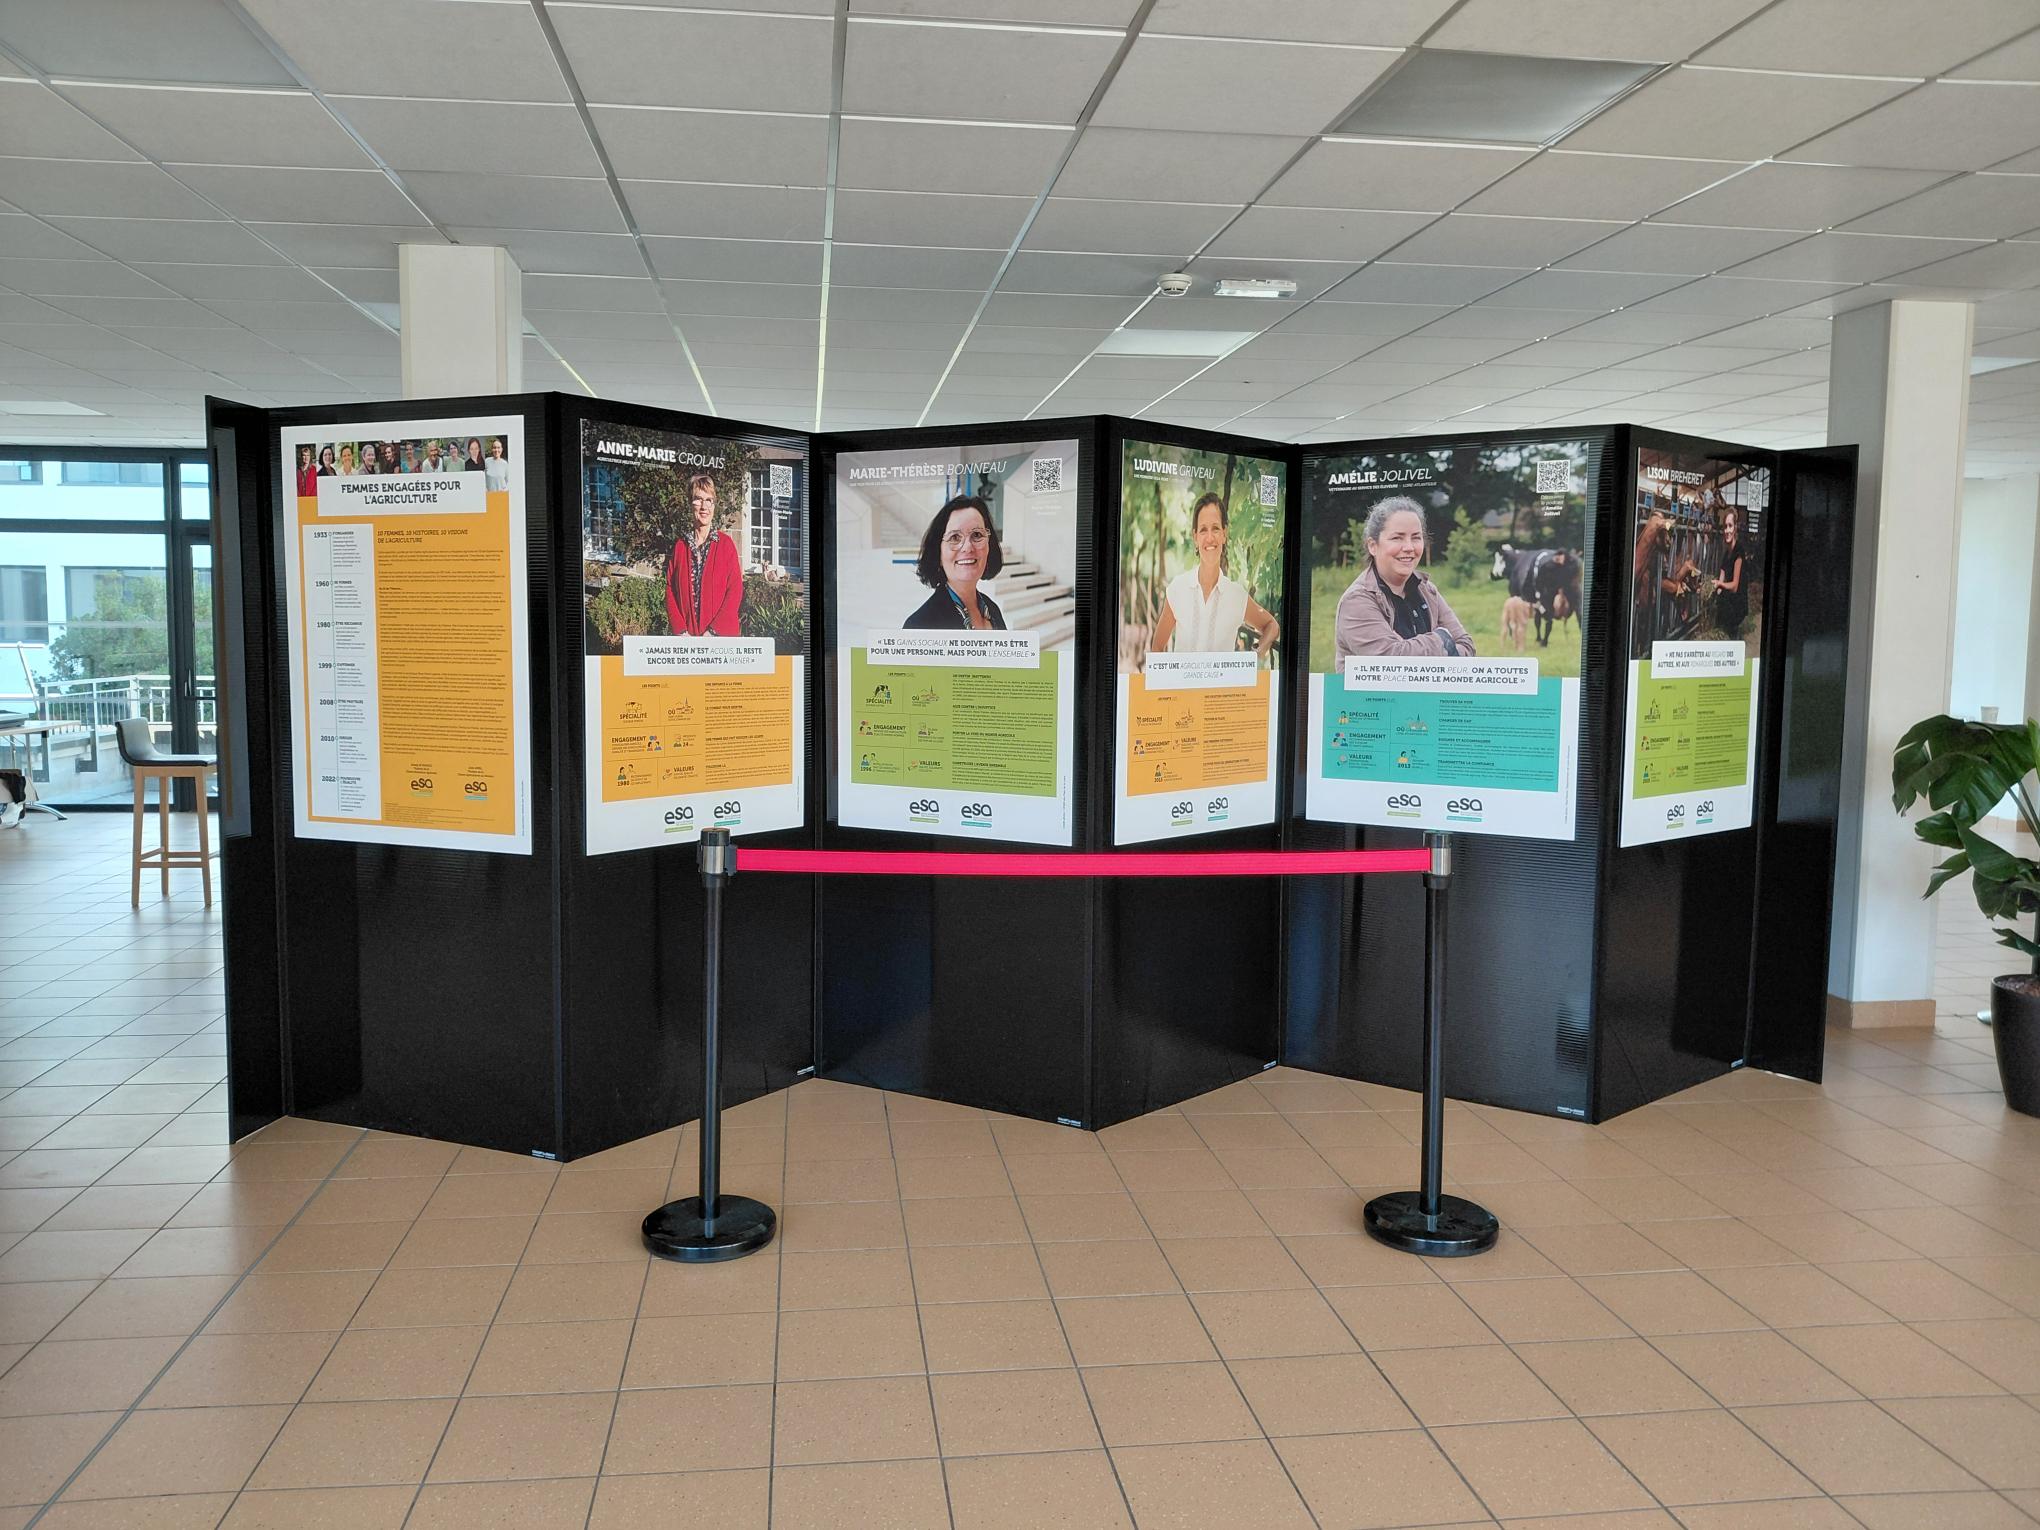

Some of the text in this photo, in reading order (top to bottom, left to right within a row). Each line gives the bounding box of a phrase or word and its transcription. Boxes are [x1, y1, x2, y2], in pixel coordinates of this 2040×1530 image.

[596, 440, 726, 470] ANNE-MARIE CROLAIS
[850, 461, 1007, 480] MARIE-THÉRÈSE BONNEAU
[1134, 458, 1178, 475] LUDIVINE
[1179, 464, 1216, 480] GRIVEAU
[1328, 468, 1432, 485] AMÉLIE JOLIVEL
[1647, 466, 1705, 485] LISON BREHERET
[341, 480, 461, 494] FEMMES ENGAGÉES POUR
[364, 494, 438, 504] L'AGRICULTURE
[917, 639, 948, 647] SOCIAUX
[1009, 638, 1028, 648] ÊTRE
[645, 647, 671, 655] JAMAIS
[673, 647, 689, 655] RIEN
[690, 647, 709, 655] N'EST
[907, 648, 946, 656] PERSONNE,
[947, 649, 965, 657] MAIS
[966, 649, 987, 657] POUR
[988, 650, 1029, 658] L'ENSEMBLE
[647, 657, 675, 665] ENCORE
[676, 657, 690, 665] DES
[691, 657, 722, 665] COMBATS
[723, 656, 729, 664] À
[1494, 667, 1529, 675] TOUTES
[1355, 674, 1382, 682] NOTRE
[1408, 675, 1430, 683] DANS
[1475, 676, 1518, 684] AGRICOLE
[410, 778, 434, 790] esa
[464, 781, 488, 794] esa
[909, 799, 939, 814] esa
[1208, 797, 1229, 814] esa
[1387, 794, 1421, 808] esa
[1447, 798, 1482, 813] esa
[1697, 800, 1713, 816] esa
[664, 806, 694, 825] esa
[714, 801, 741, 818] esa
[961, 803, 992, 818] esa
[1172, 801, 1193, 818] esa
[1667, 804, 1684, 821] esa
